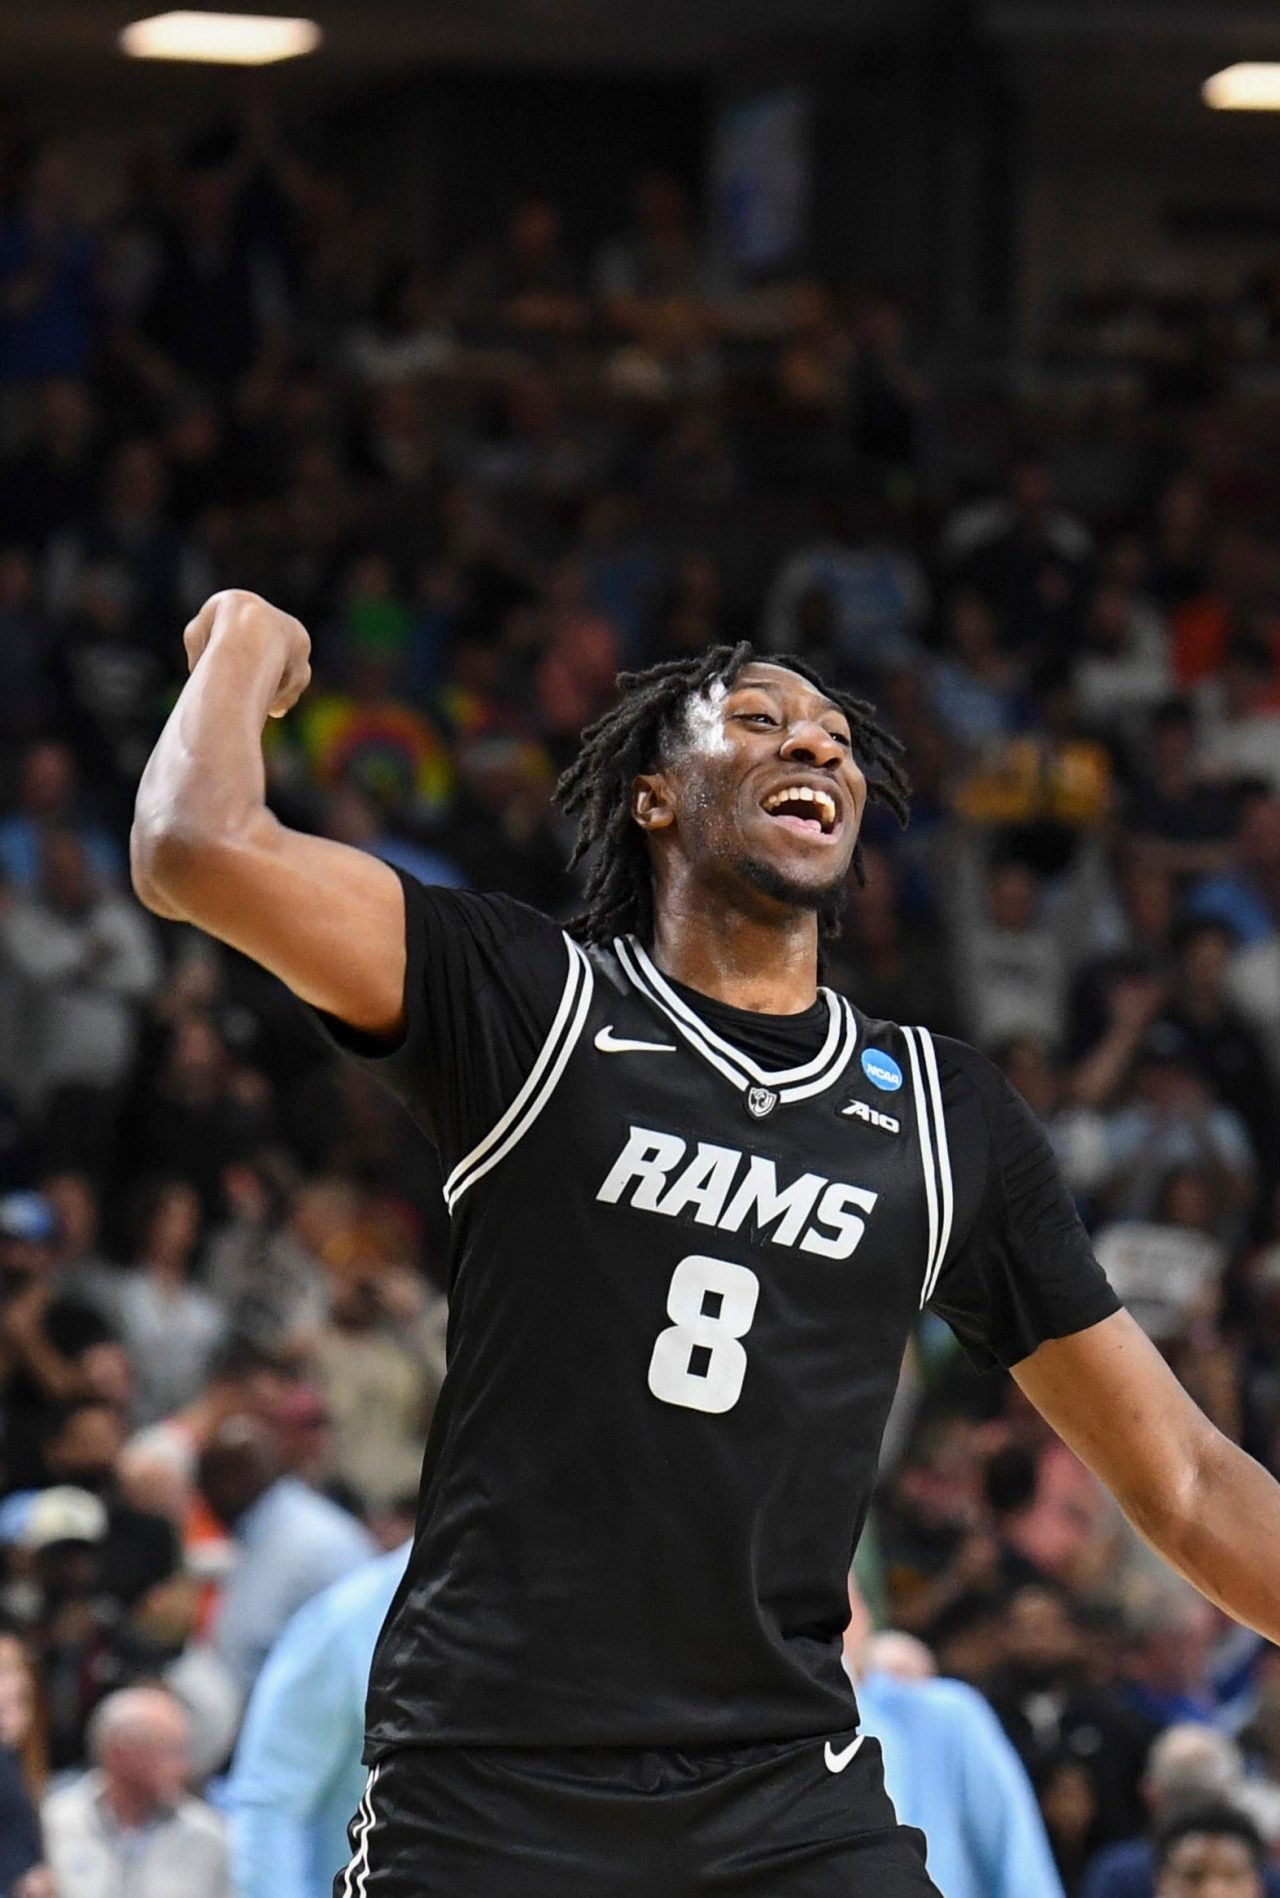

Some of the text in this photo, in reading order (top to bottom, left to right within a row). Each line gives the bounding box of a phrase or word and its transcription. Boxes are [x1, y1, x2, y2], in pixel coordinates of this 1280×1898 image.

[841, 1099, 900, 1134] A10
[866, 1063, 899, 1085] NCAA
[596, 1125, 878, 1260] RAMS
[647, 1254, 760, 1414] 8
